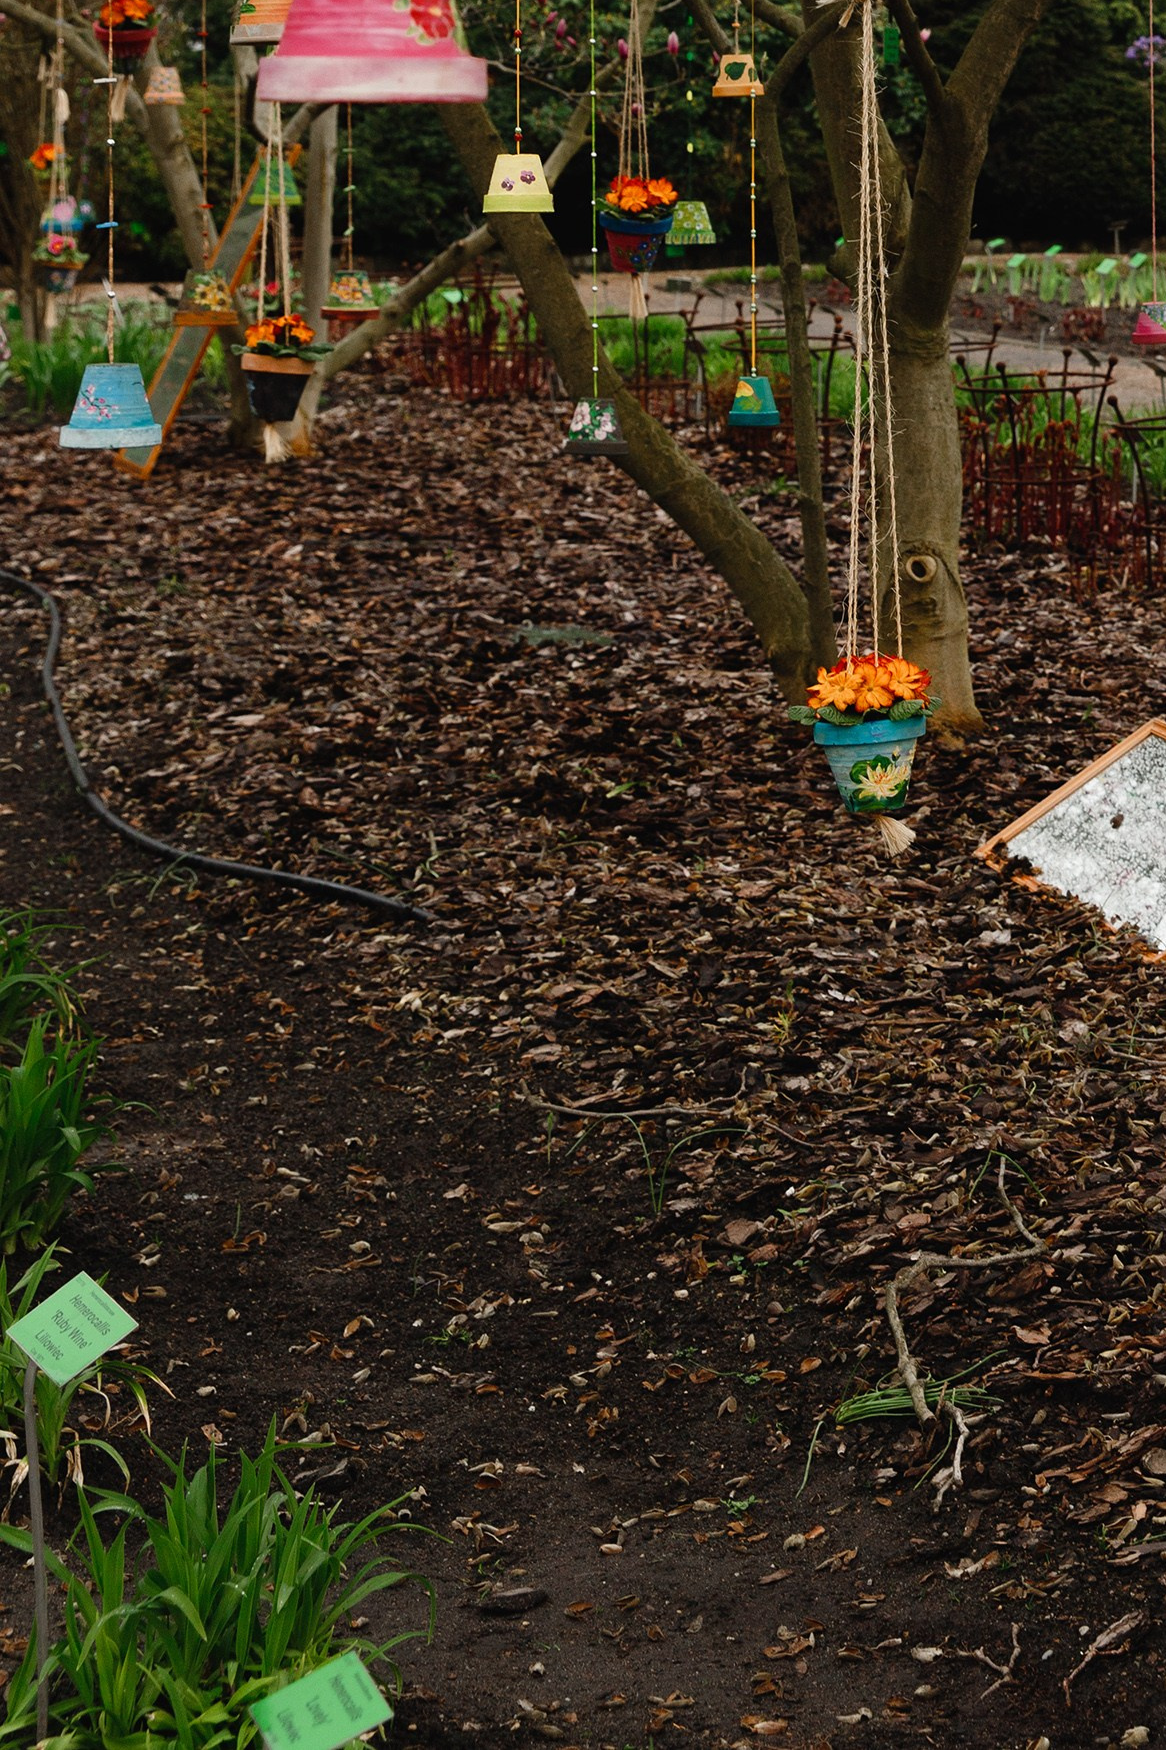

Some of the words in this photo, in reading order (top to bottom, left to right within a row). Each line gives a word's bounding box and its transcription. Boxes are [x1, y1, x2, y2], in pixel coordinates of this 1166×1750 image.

[51, 1309, 72, 1334] 'Ruby
[70, 1326, 93, 1350] Wine'
[69, 1294, 111, 1337] Hemerocallis
[35, 1329, 65, 1361] Liliowiec
